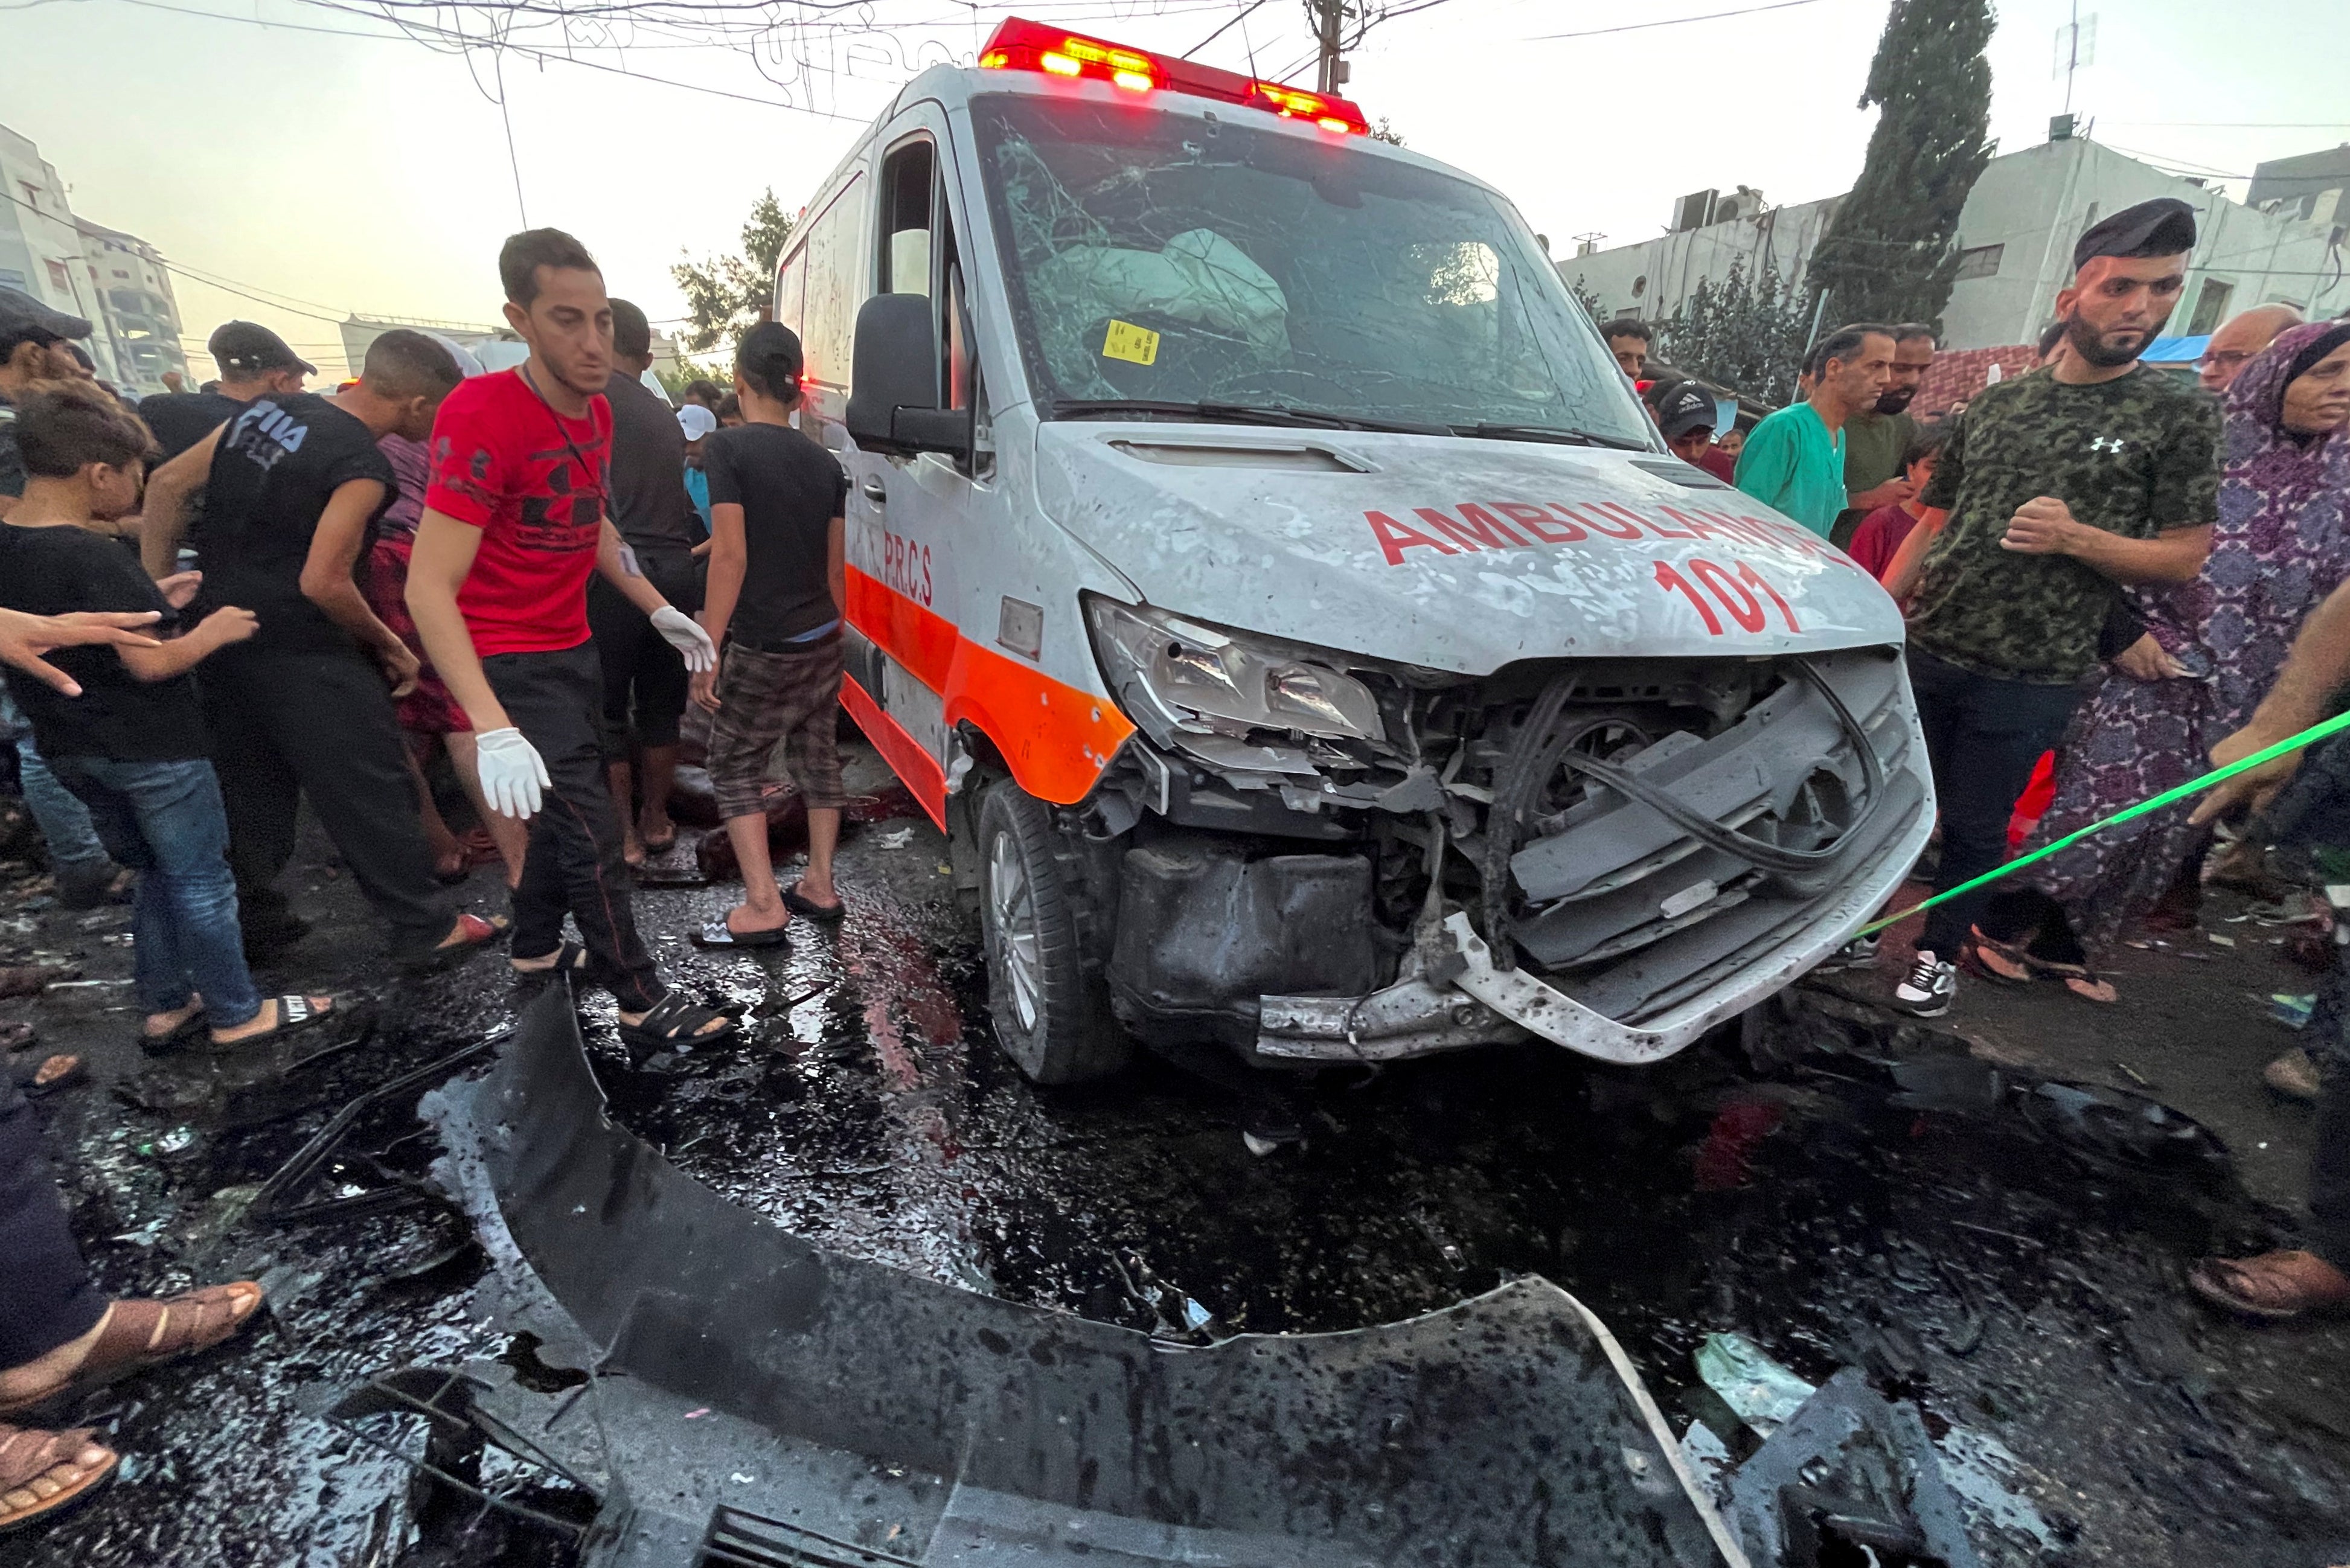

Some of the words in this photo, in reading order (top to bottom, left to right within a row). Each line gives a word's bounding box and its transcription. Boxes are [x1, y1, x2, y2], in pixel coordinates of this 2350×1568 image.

[226, 400, 307, 452] FILA
[1362, 502, 1854, 568] AMBULANCE
[1652, 559, 1801, 636] 101
